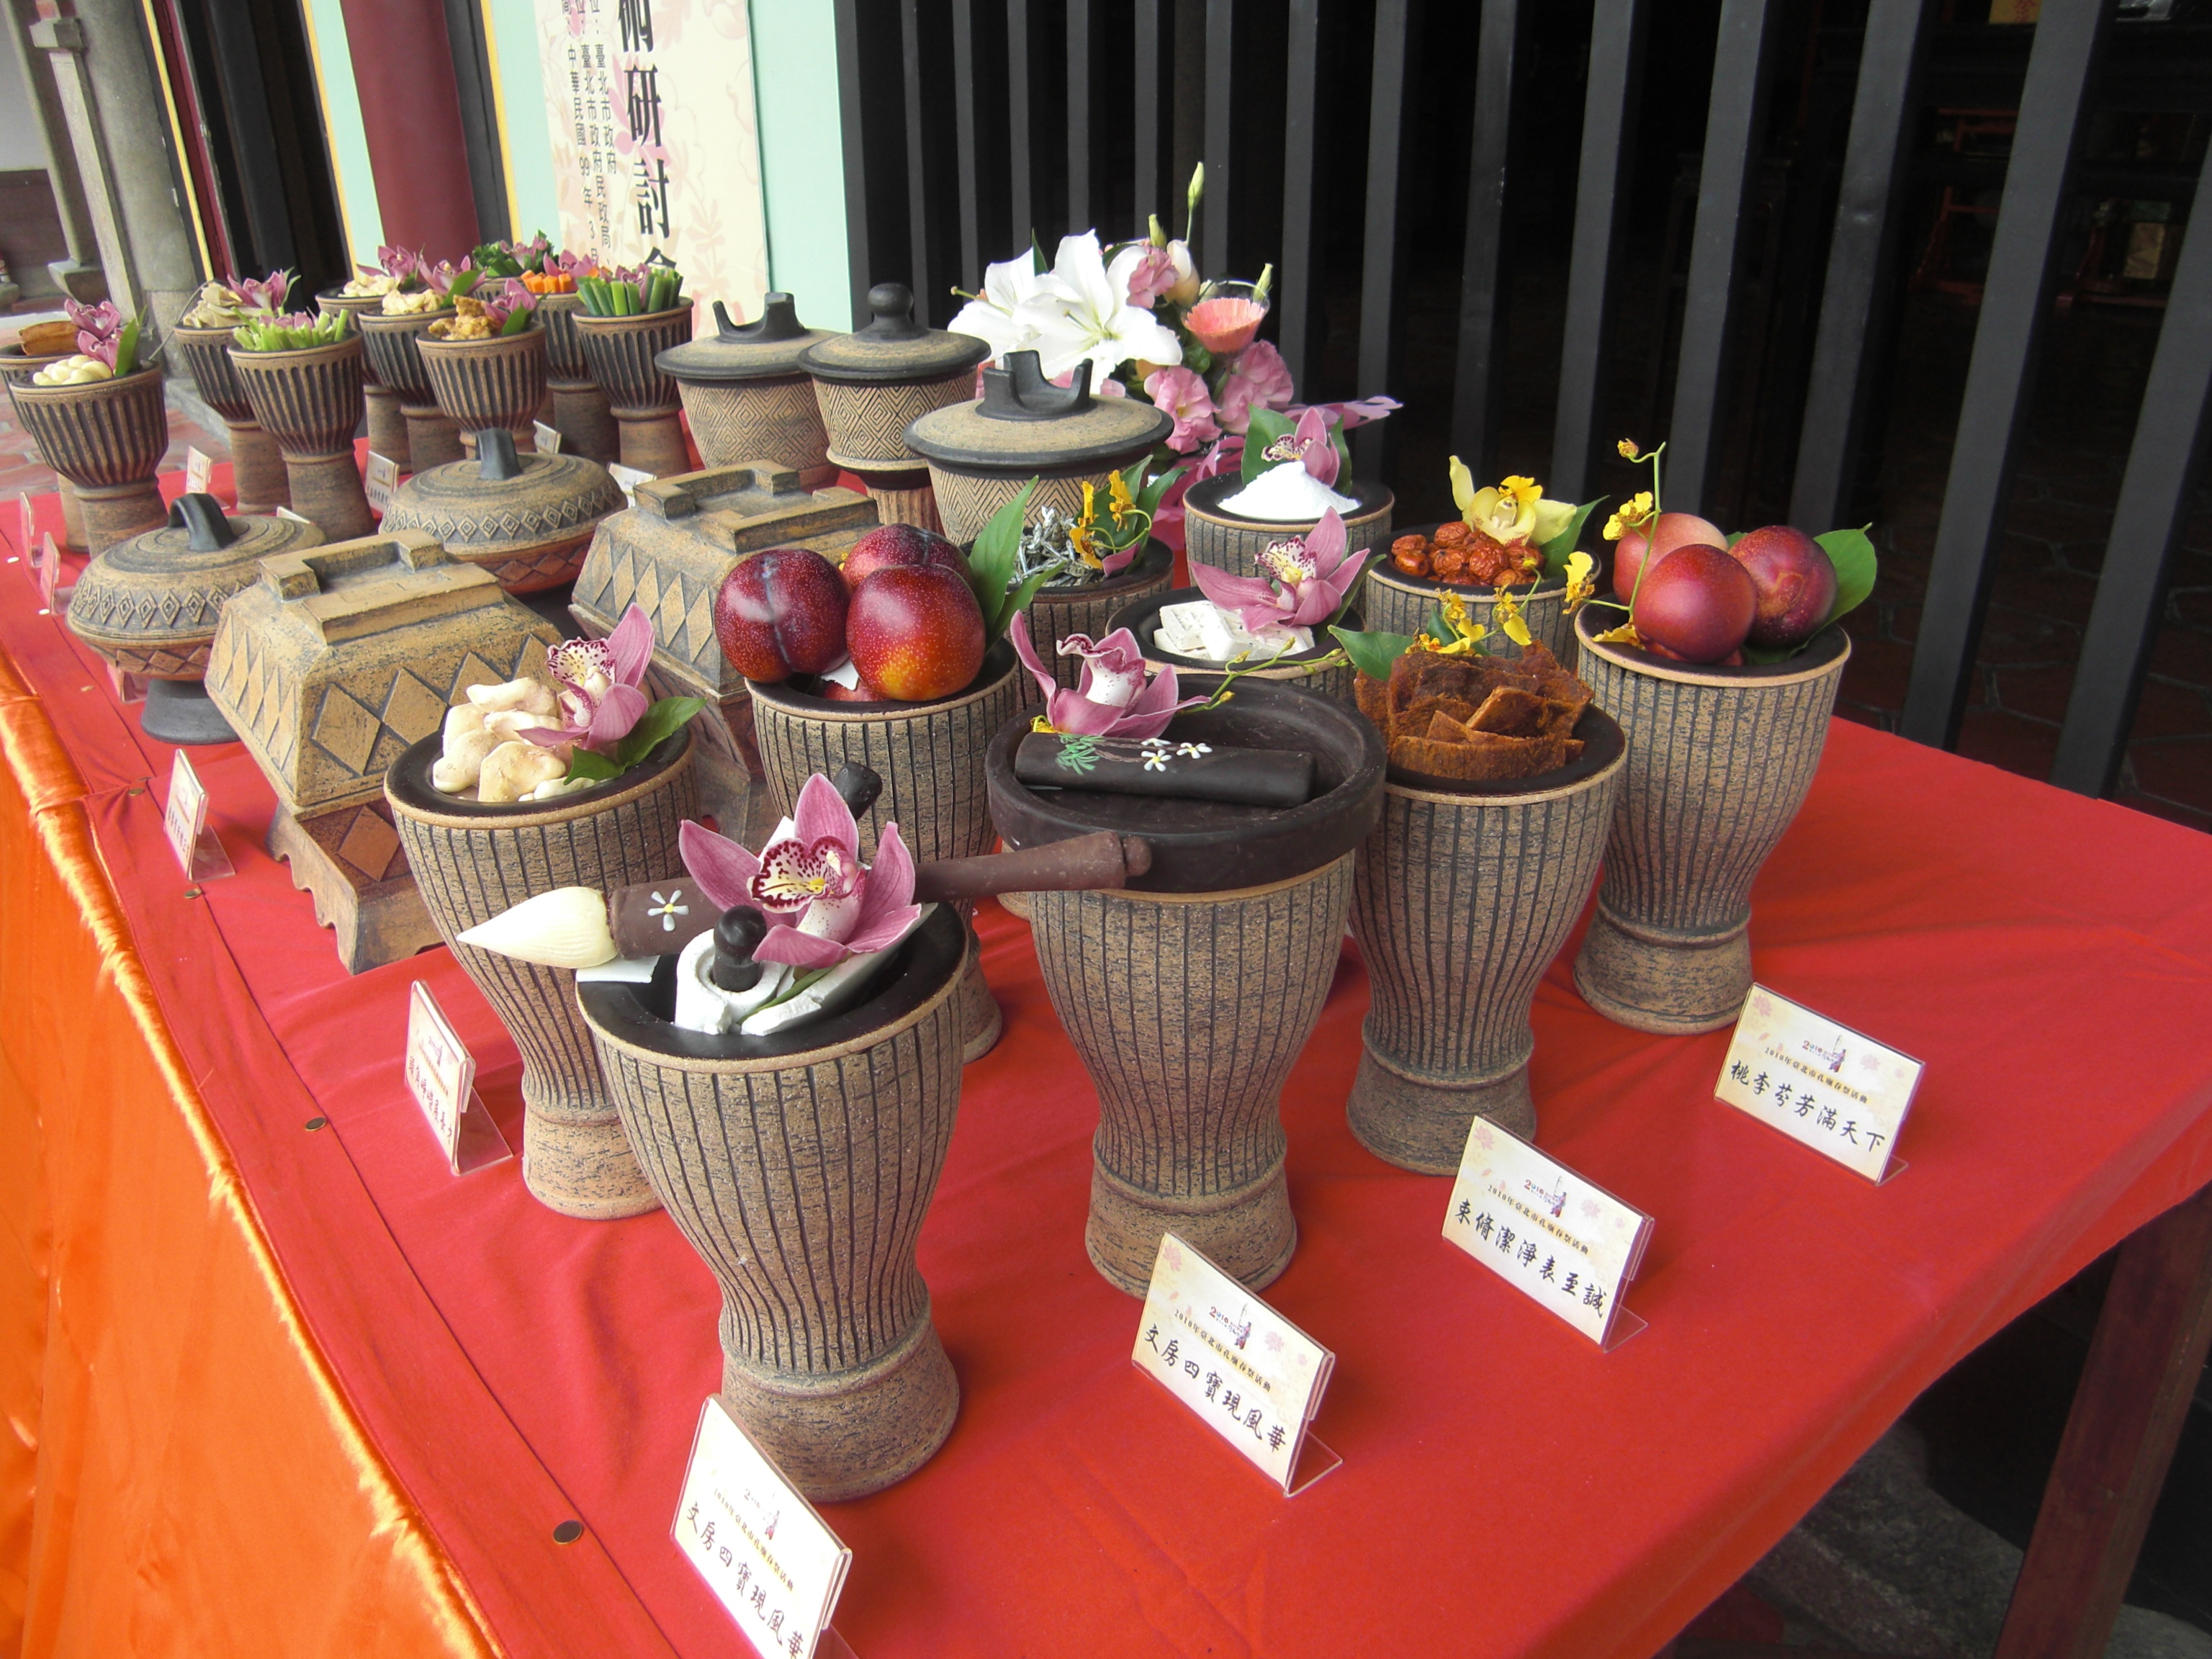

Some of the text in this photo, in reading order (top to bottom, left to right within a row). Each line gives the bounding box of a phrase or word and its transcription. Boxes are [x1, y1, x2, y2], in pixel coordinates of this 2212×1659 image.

[1730, 1059, 1886, 1153] 桃李芬芳滿天下
[1145, 1323, 1287, 1453] 文房四寶現風華
[686, 1500, 804, 1659] 文房四寶現風華
